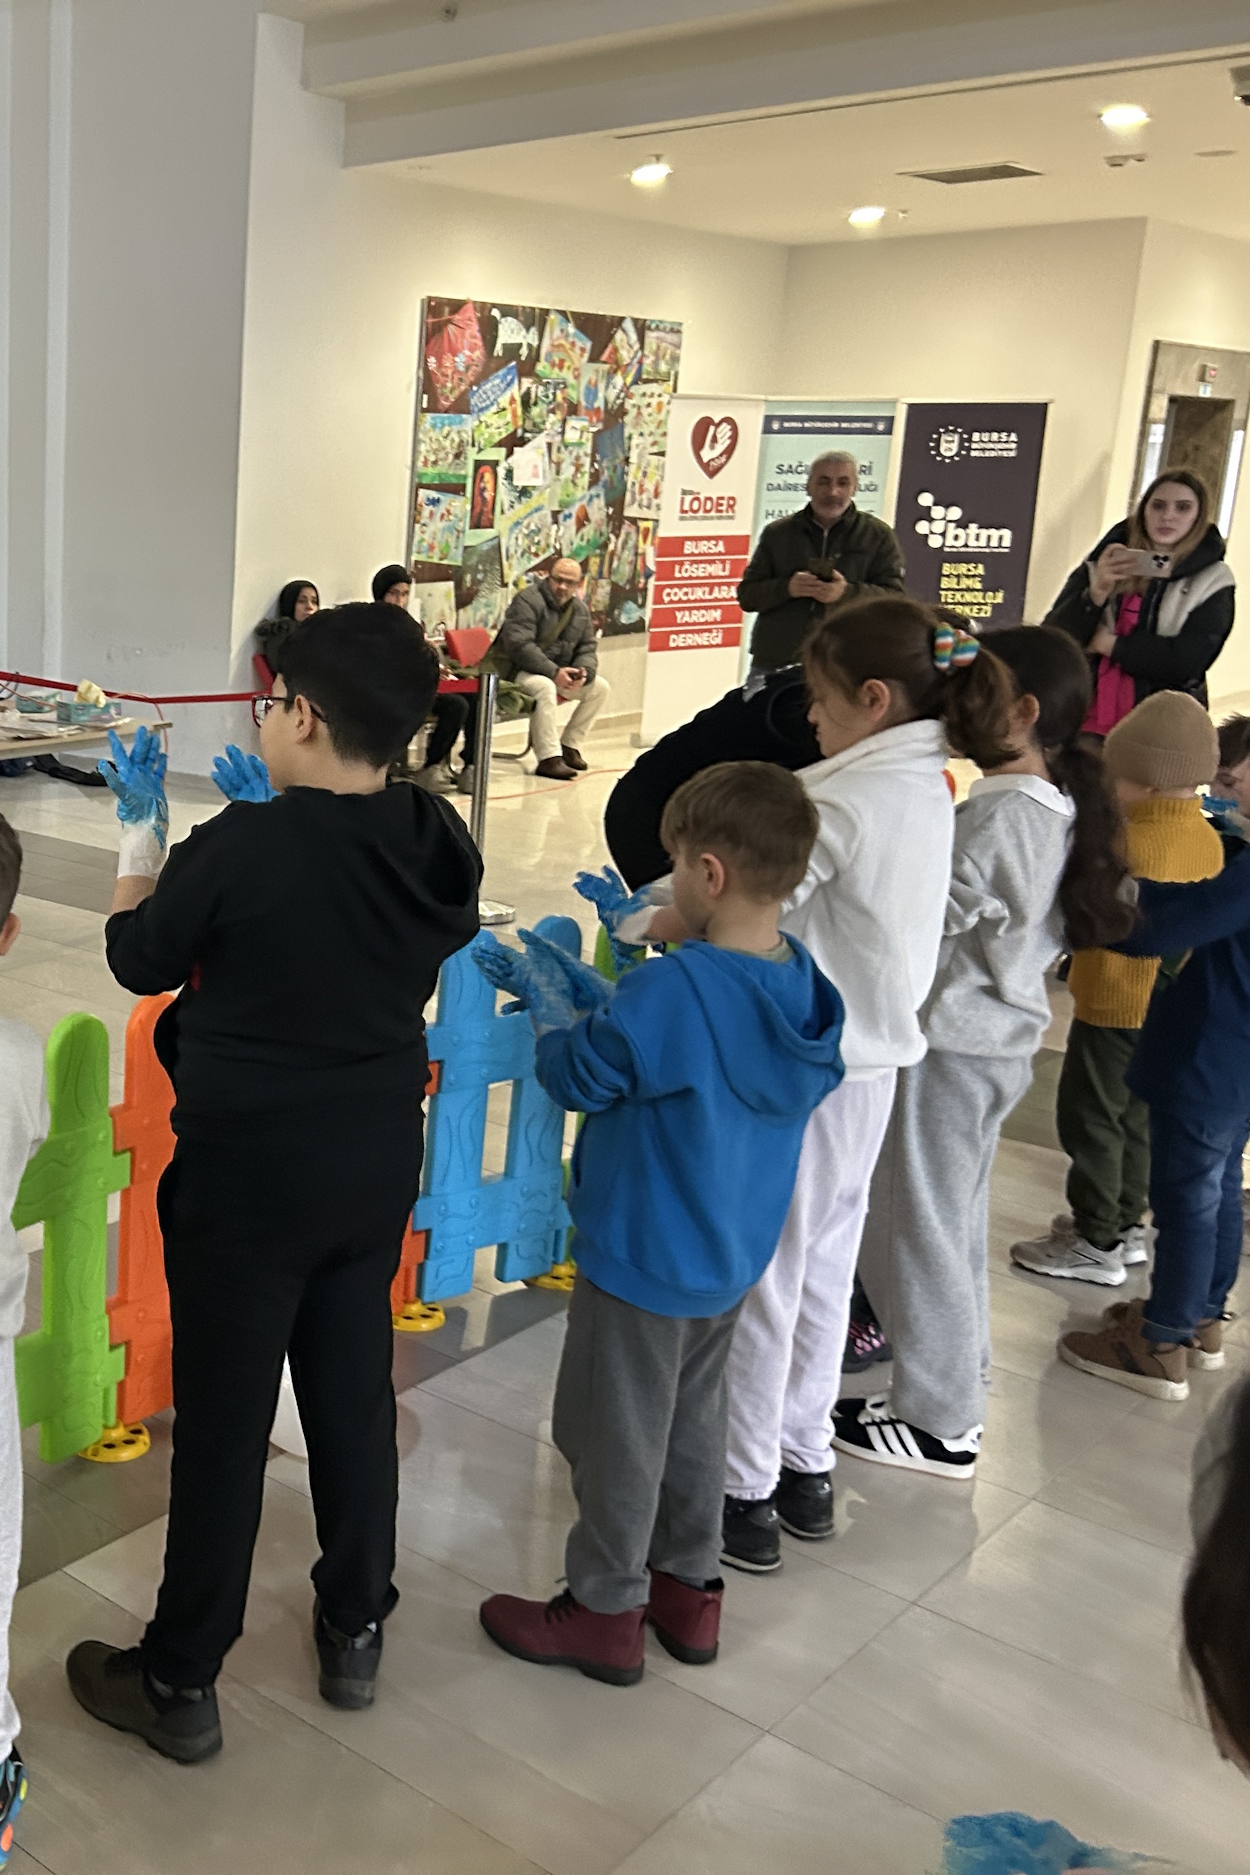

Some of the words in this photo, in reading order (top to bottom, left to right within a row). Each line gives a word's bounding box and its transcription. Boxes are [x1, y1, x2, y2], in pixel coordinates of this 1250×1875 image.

[971, 431, 1019, 442] BURSA
[945, 522, 1013, 548] btm
[683, 540, 726, 555] BURSA
[673, 560, 731, 578] LÖSEMİLİ
[941, 562, 986, 576] BURSA
[661, 585, 738, 605] ÇOCUKLARA
[938, 587, 1006, 604] TEKNOLOJİ
[674, 608, 722, 624] YARDIM
[668, 629, 724, 648] DERNEĞİ
